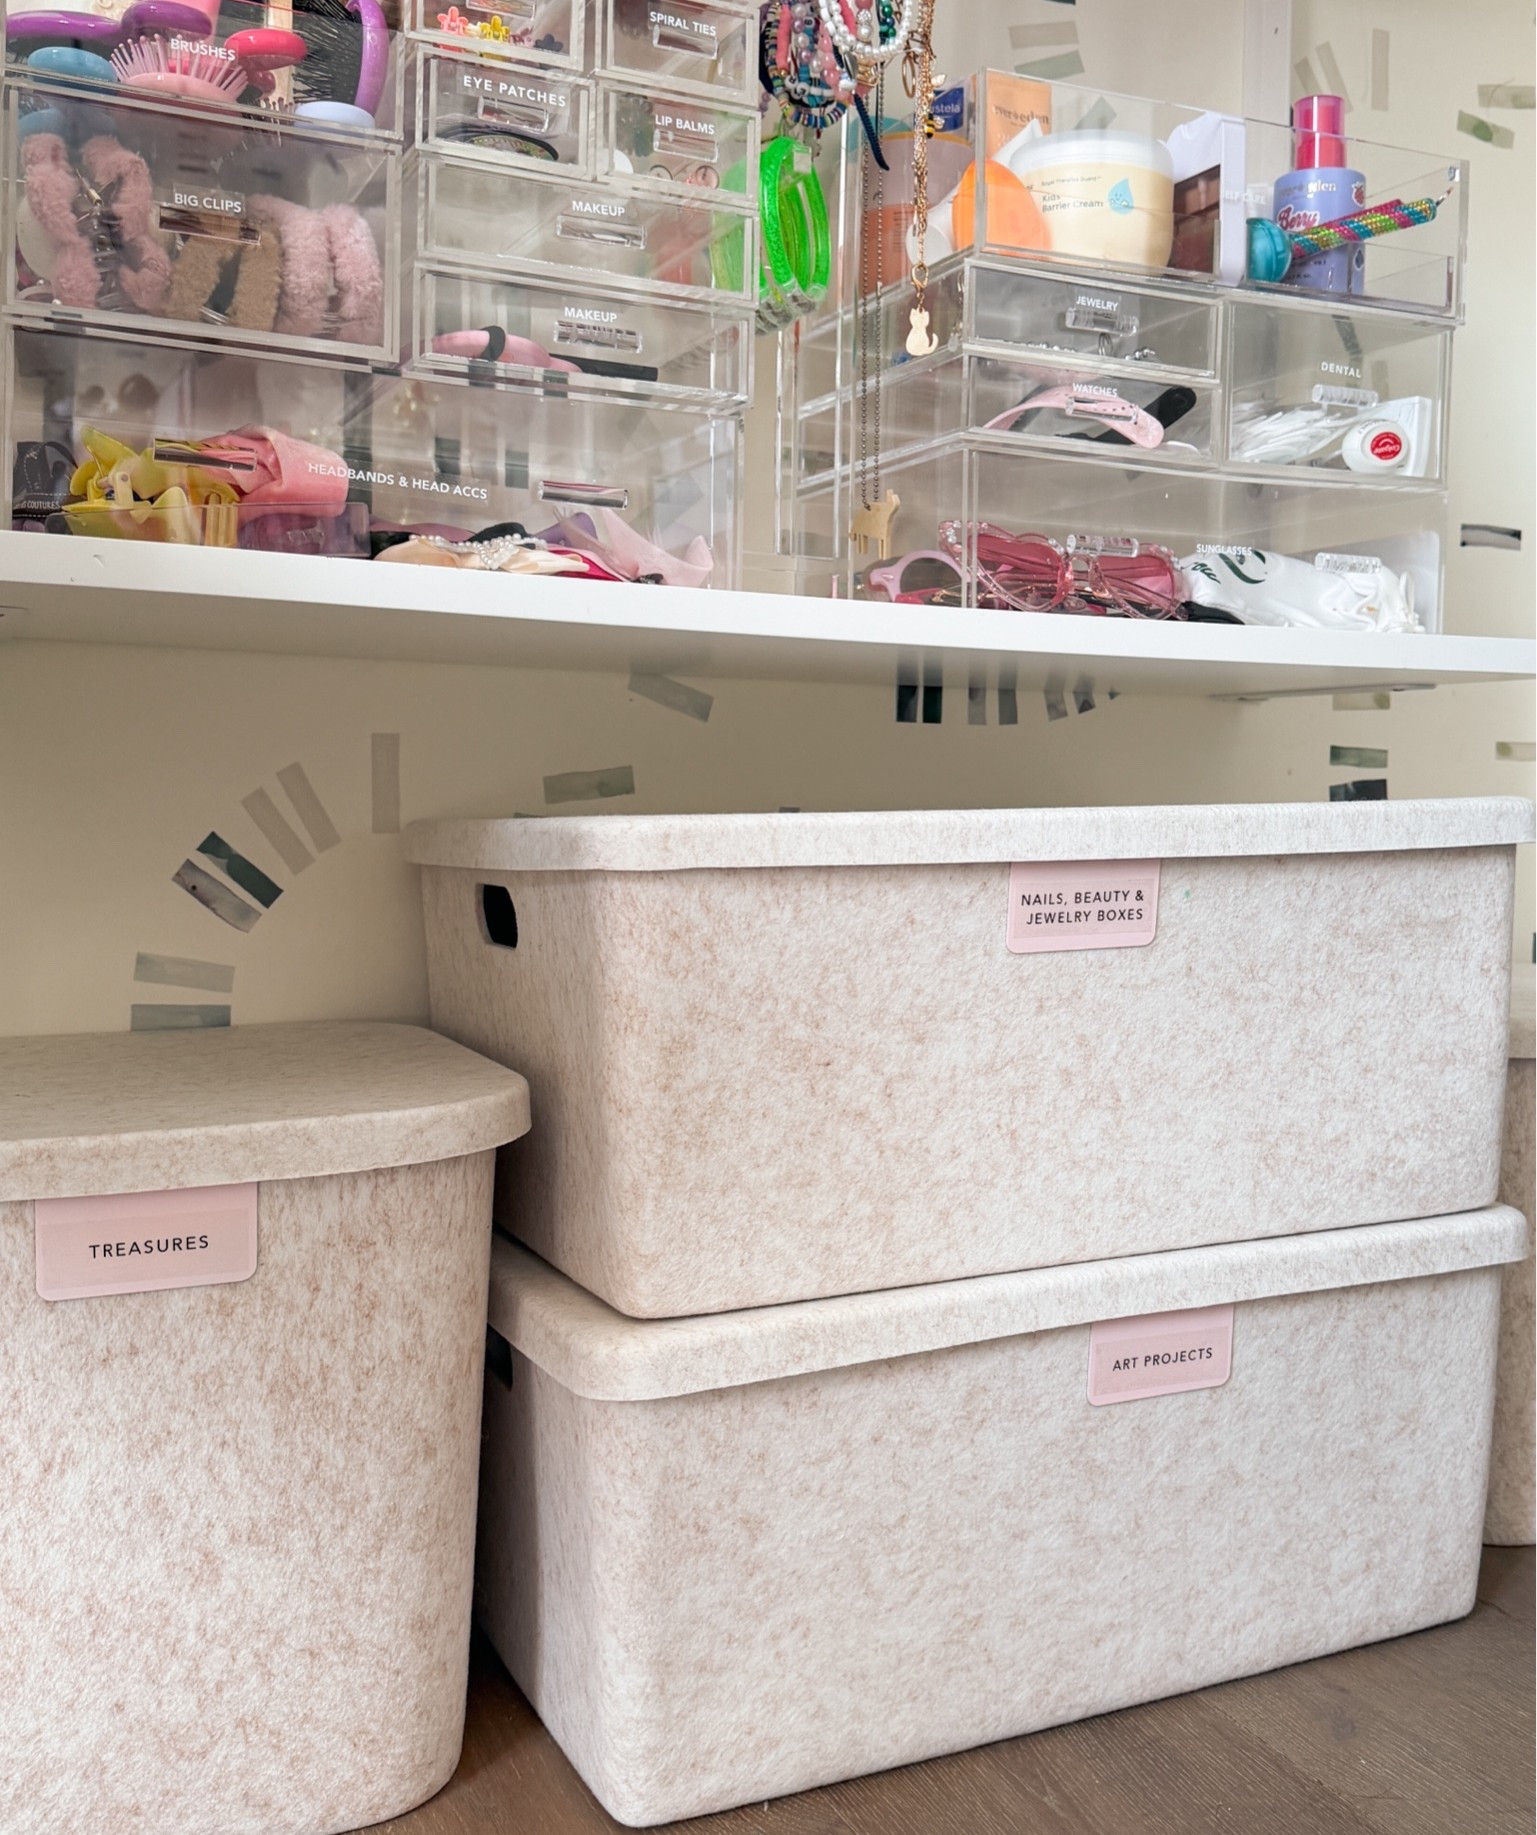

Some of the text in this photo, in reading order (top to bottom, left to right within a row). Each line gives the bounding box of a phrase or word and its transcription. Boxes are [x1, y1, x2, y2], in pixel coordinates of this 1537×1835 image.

[649, 11, 717, 37] SPIRAL TIES
[170, 38, 236, 61] BRUSHES
[463, 75, 567, 108] EYE PATCHES
[655, 114, 715, 135] LIP BALMS
[174, 193, 242, 213] BIG CLIPS
[1042, 193, 1061, 202] Kids
[572, 200, 626, 217] MAKEUP
[1042, 200, 1104, 213] Barrier Cream
[1277, 205, 1318, 231] Berry
[1076, 296, 1119, 312] JEWELRY
[564, 306, 618, 323] MAKEUP
[1321, 361, 1361, 378] DENTAL
[1072, 382, 1118, 398] WATCHES
[308, 462, 488, 500] HEADBANDS & HEAD ACCS
[27, 500, 61, 510] COUTURES
[1196, 543, 1252, 556] SUNGLASSES
[1021, 889, 1144, 906] NAILS, BEAUTY &
[1026, 908, 1143, 925] JEWELRY BOXES
[89, 1235, 209, 1259] TREASURES
[1112, 1347, 1213, 1372] ART PROJECTS
